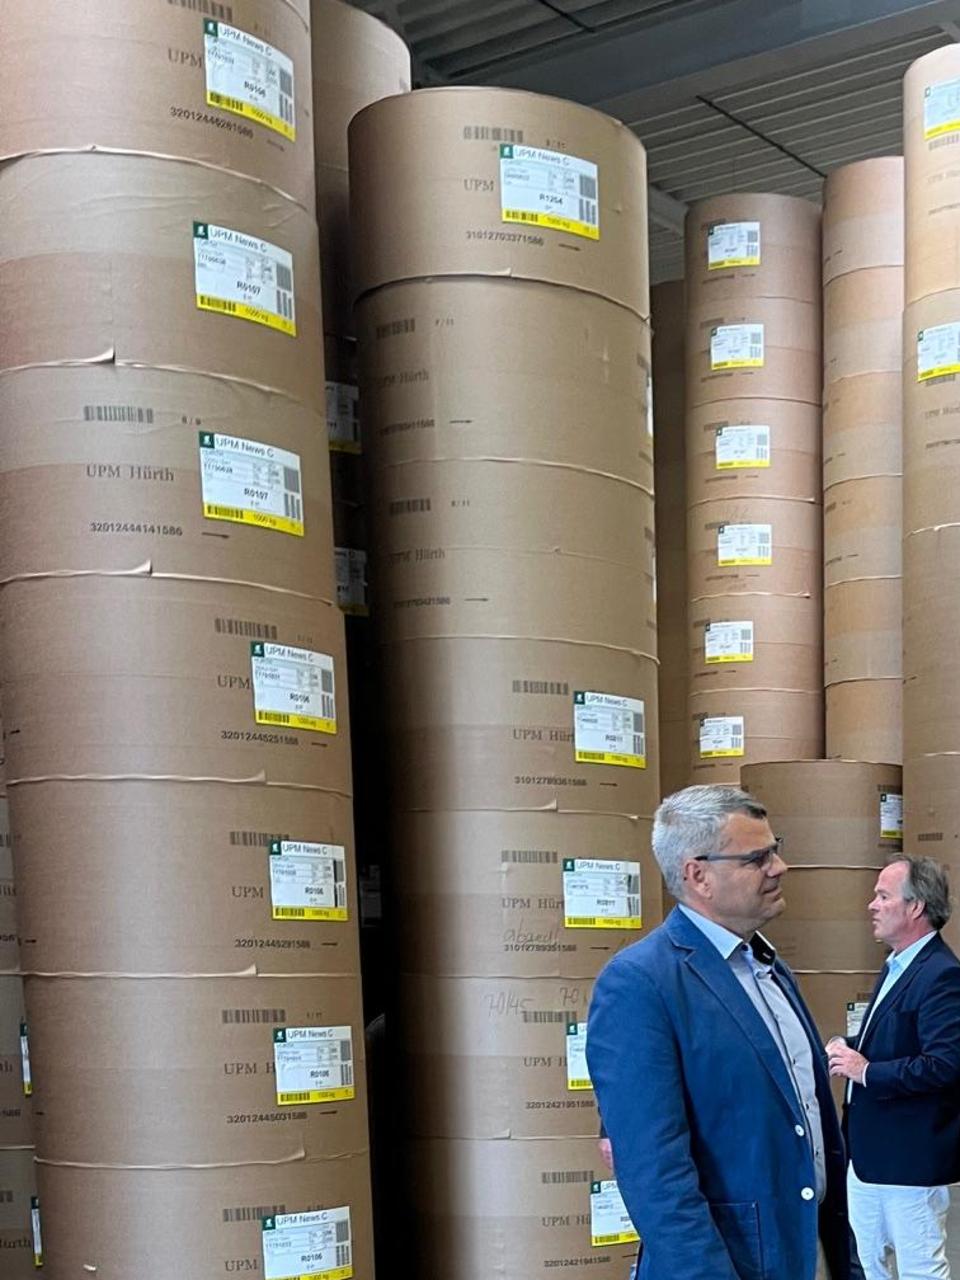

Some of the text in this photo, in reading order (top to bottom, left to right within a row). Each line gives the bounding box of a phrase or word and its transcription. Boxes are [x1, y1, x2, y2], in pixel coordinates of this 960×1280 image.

[220, 25, 272, 56] UPM News C
[168, 48, 202, 68] UPM
[516, 149, 536, 160] UPM
[538, 152, 561, 165] News
[464, 179, 494, 191] UPM
[210, 228, 267, 253] UPM News C
[216, 438, 274, 458] UPM News C
[87, 465, 174, 481] UPM Hürth
[266, 646, 313, 662] UPM News C
[217, 675, 250, 689] UPM
[586, 695, 604, 704] UPM
[605, 697, 621, 706] News
[513, 729, 574, 741] UPM Hür
[283, 844, 328, 855] UPM News C
[576, 862, 594, 870] UPM
[596, 863, 614, 871] News
[232, 886, 264, 898] UPM
[502, 898, 564, 909] UPM Hür
[288, 1029, 333, 1039] UPM News C
[224, 1062, 257, 1074] UPM
[524, 1057, 551, 1067] UPM
[277, 1212, 328, 1226] UPM News C
[542, 1216, 570, 1227] UPM
[224, 1260, 258, 1271] UPM
